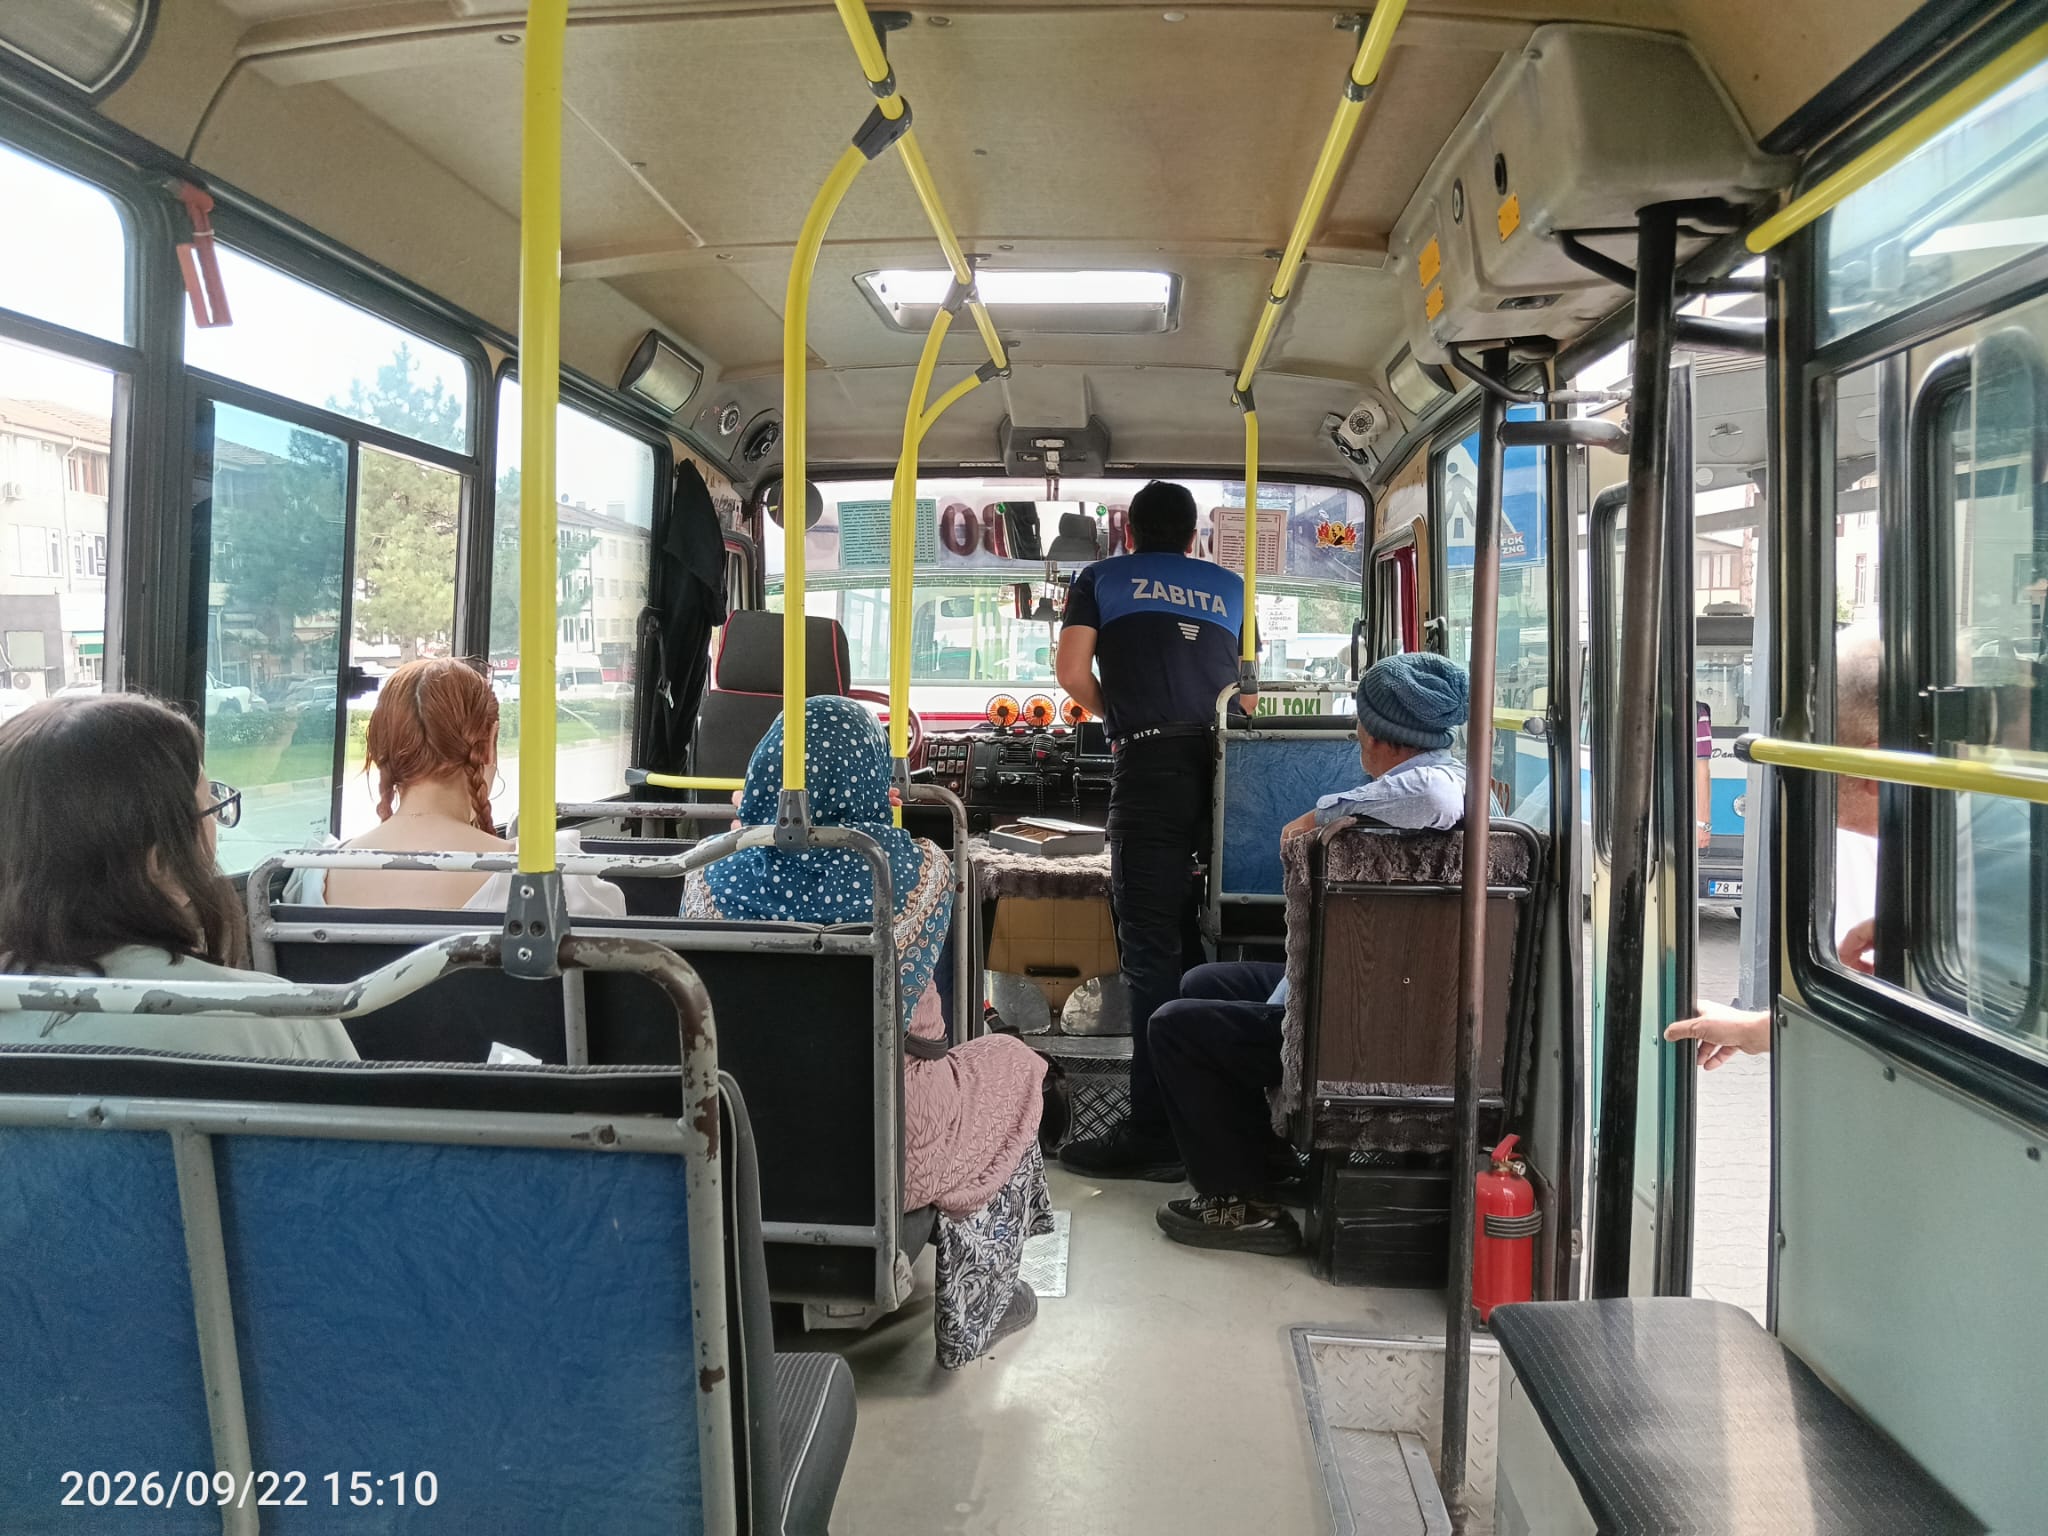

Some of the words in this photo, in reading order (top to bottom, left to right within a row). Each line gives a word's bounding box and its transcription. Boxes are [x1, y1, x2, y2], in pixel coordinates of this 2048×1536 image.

[1131, 578, 1228, 618] ZABITA
[1253, 696, 1277, 717] SU
[1119, 728, 1161, 745] ZBITA
[1712, 747, 1736, 759] Dan
[1716, 881, 1730, 893] 78
